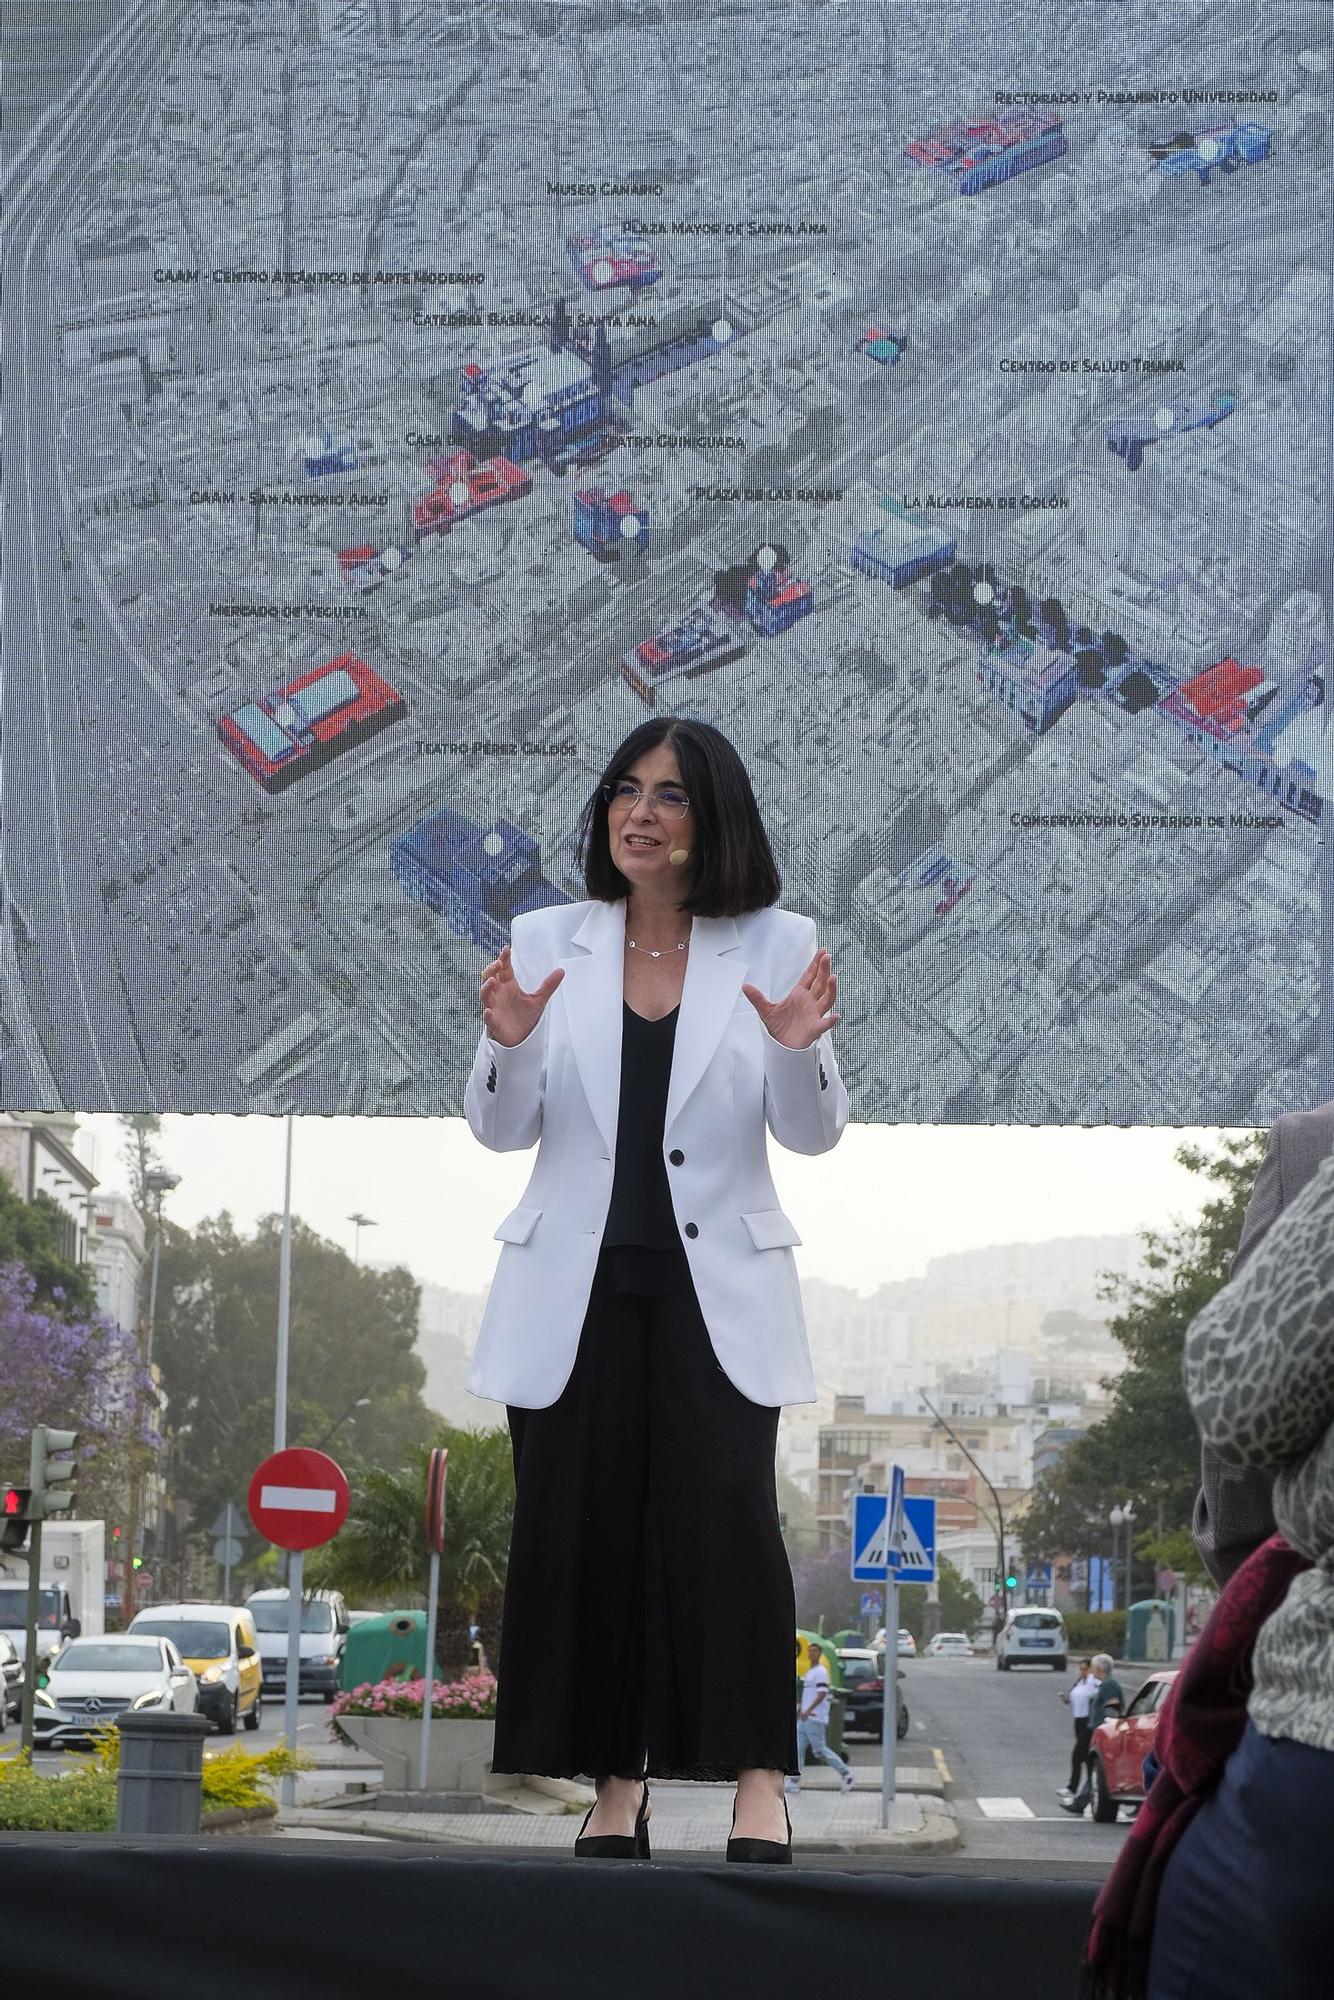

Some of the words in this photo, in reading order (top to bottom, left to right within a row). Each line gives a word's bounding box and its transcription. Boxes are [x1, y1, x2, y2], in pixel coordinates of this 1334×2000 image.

[1083, 92, 1092, 103] Y
[725, 224, 743, 235] DE
[797, 222, 828, 235] ANA
[351, 271, 371, 284] DE
[626, 315, 657, 327] ANA
[1059, 361, 1079, 372] DE
[249, 492, 279, 507] SAN
[745, 490, 765, 502] DE
[769, 489, 796, 502] LAS
[904, 494, 923, 509] LA
[998, 495, 1016, 510] DE
[282, 606, 301, 618] DE
[1207, 815, 1225, 829] DE
